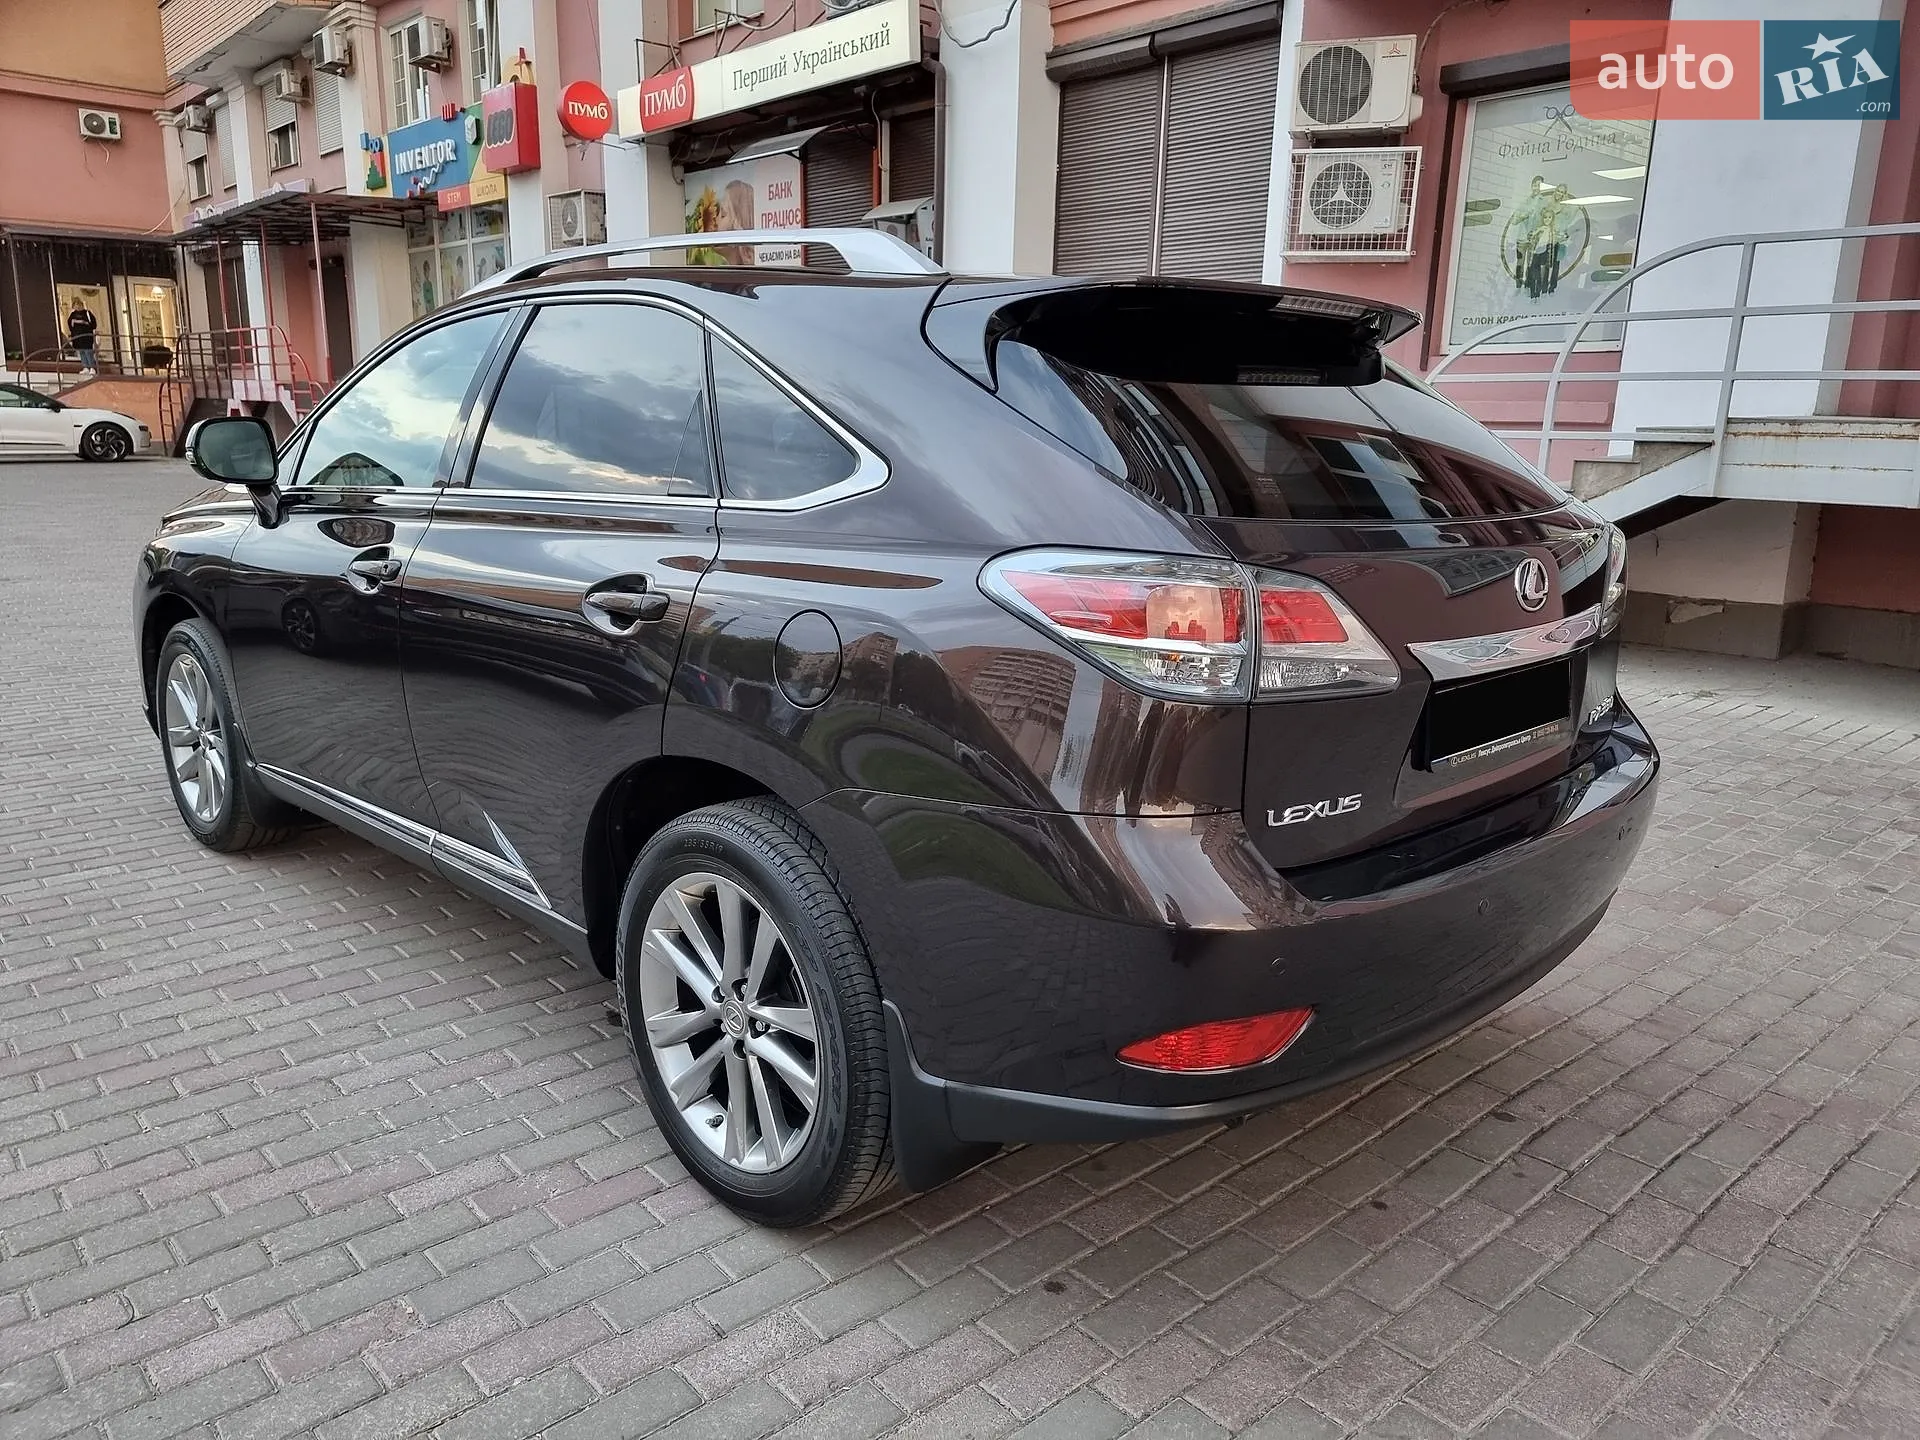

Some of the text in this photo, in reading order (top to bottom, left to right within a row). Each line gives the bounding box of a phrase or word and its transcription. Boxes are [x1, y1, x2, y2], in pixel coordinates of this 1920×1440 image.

[732, 21, 891, 92] Перший Український
[394, 139, 457, 175] INVENTOR
[1498, 131, 1617, 159] Файна Родина
[768, 180, 793, 201] БАНК
[761, 208, 802, 230] ПРАЦЮЄ
[785, 250, 792, 261] НА
[1462, 316, 1494, 326] САЛОН
[1266, 792, 1363, 828] LEXUS
